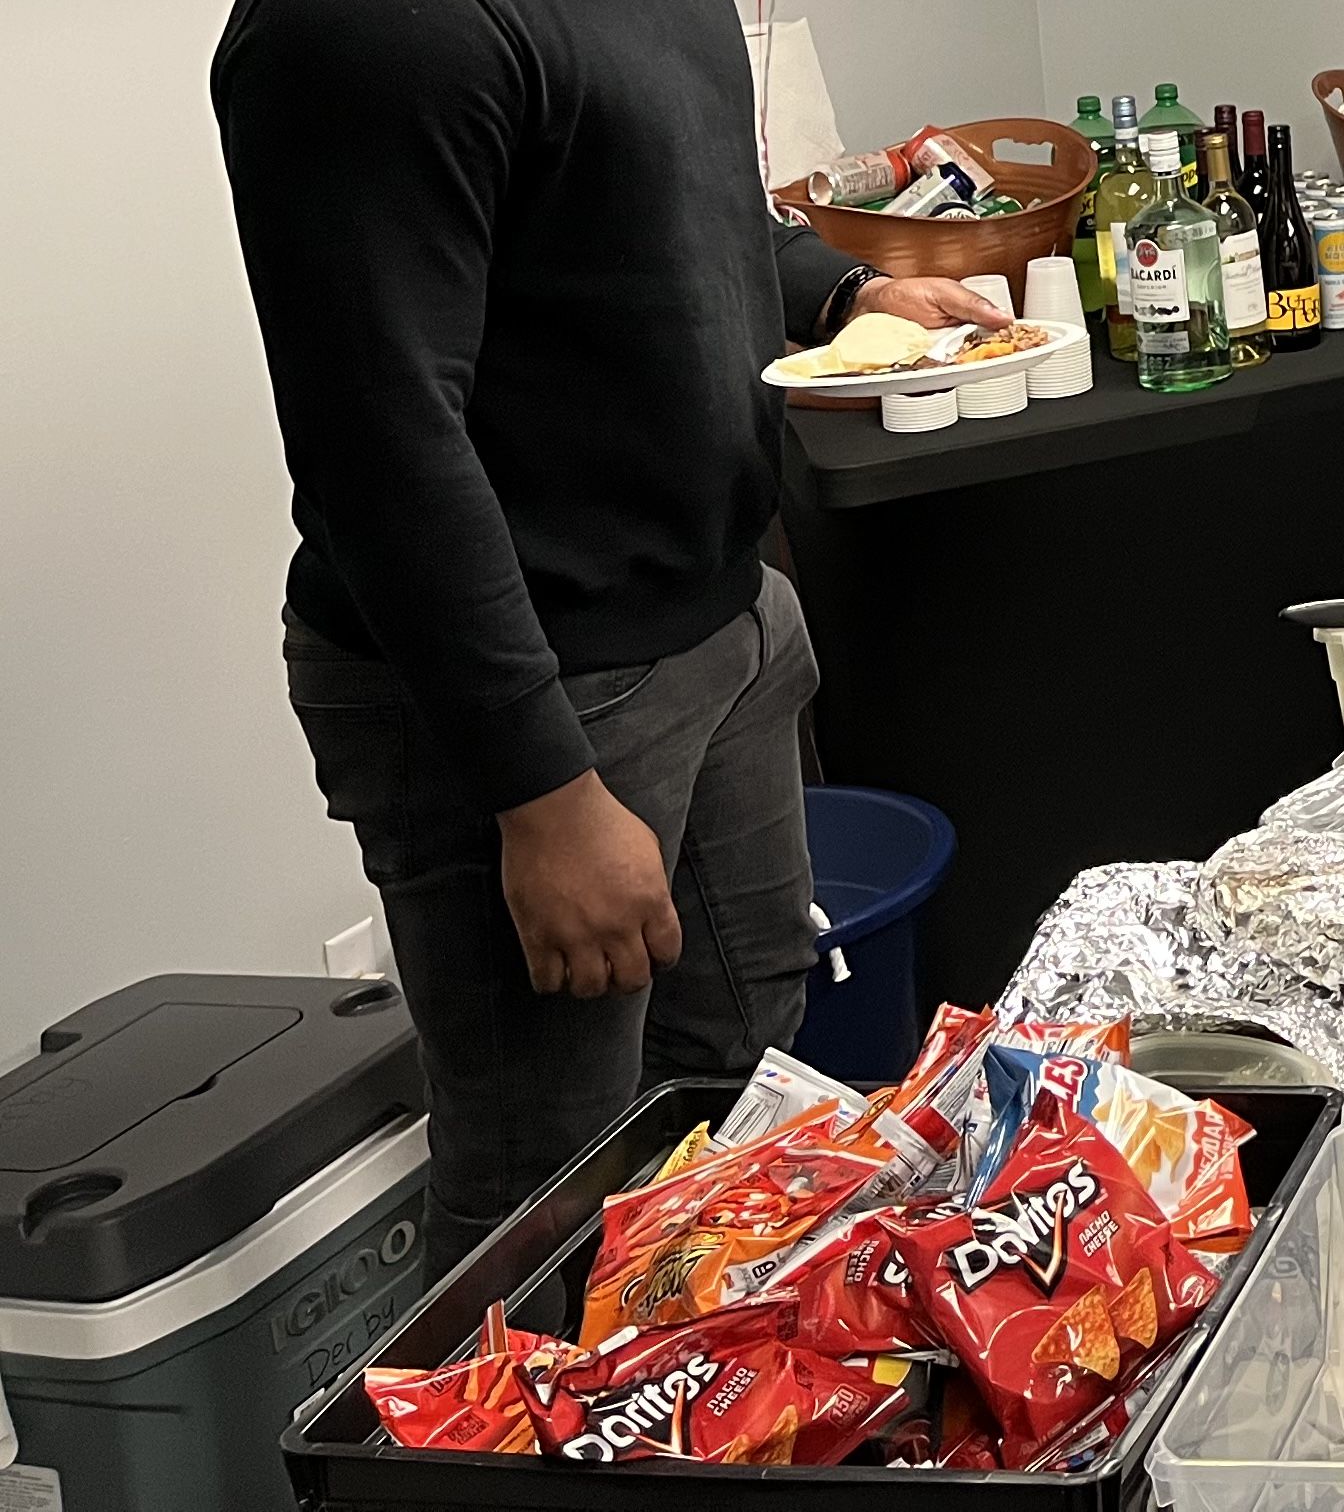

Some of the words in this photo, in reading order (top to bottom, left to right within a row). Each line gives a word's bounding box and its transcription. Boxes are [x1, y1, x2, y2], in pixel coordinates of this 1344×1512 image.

[1078, 1209, 1111, 1246] NACHO
[1083, 1220, 1119, 1258] CHEESE
[852, 1238, 881, 1283] NACHO
[562, 1351, 720, 1463] Doritos
[706, 1366, 749, 1409] NACHO
[713, 1368, 760, 1417] CHEESE
